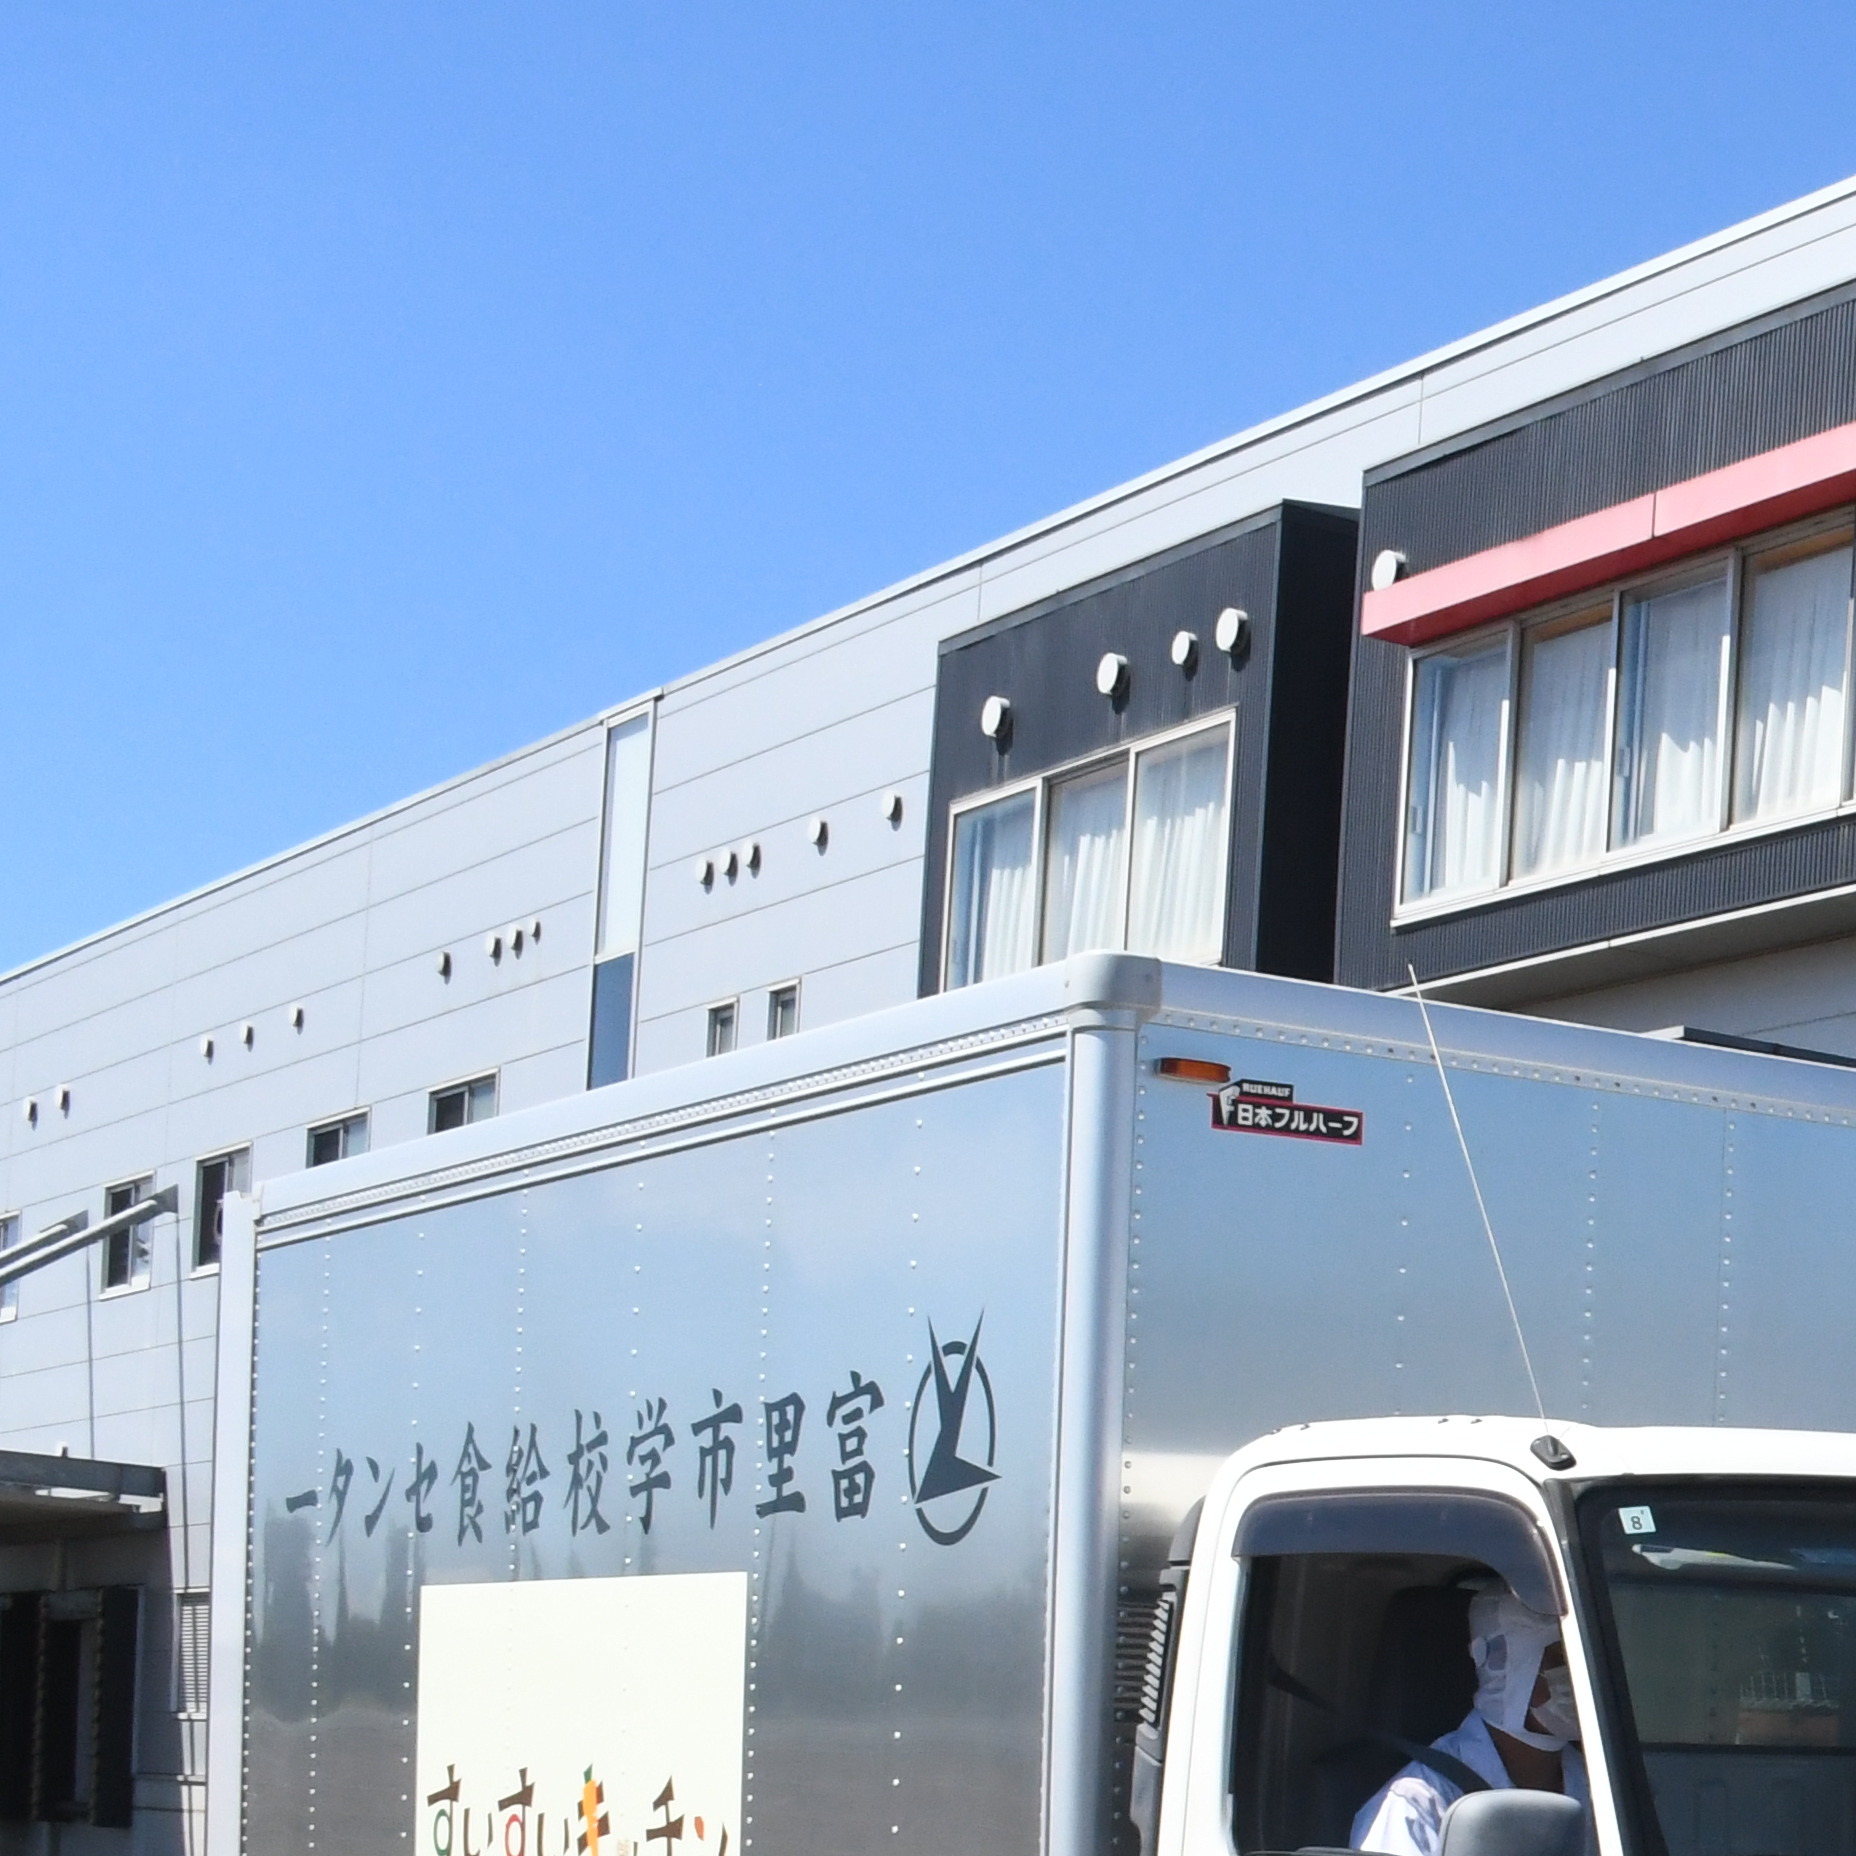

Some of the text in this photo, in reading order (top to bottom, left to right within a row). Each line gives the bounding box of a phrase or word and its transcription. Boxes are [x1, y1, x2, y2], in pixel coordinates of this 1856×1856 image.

[1237, 1103, 1360, 1137] 日本フルハーフ
